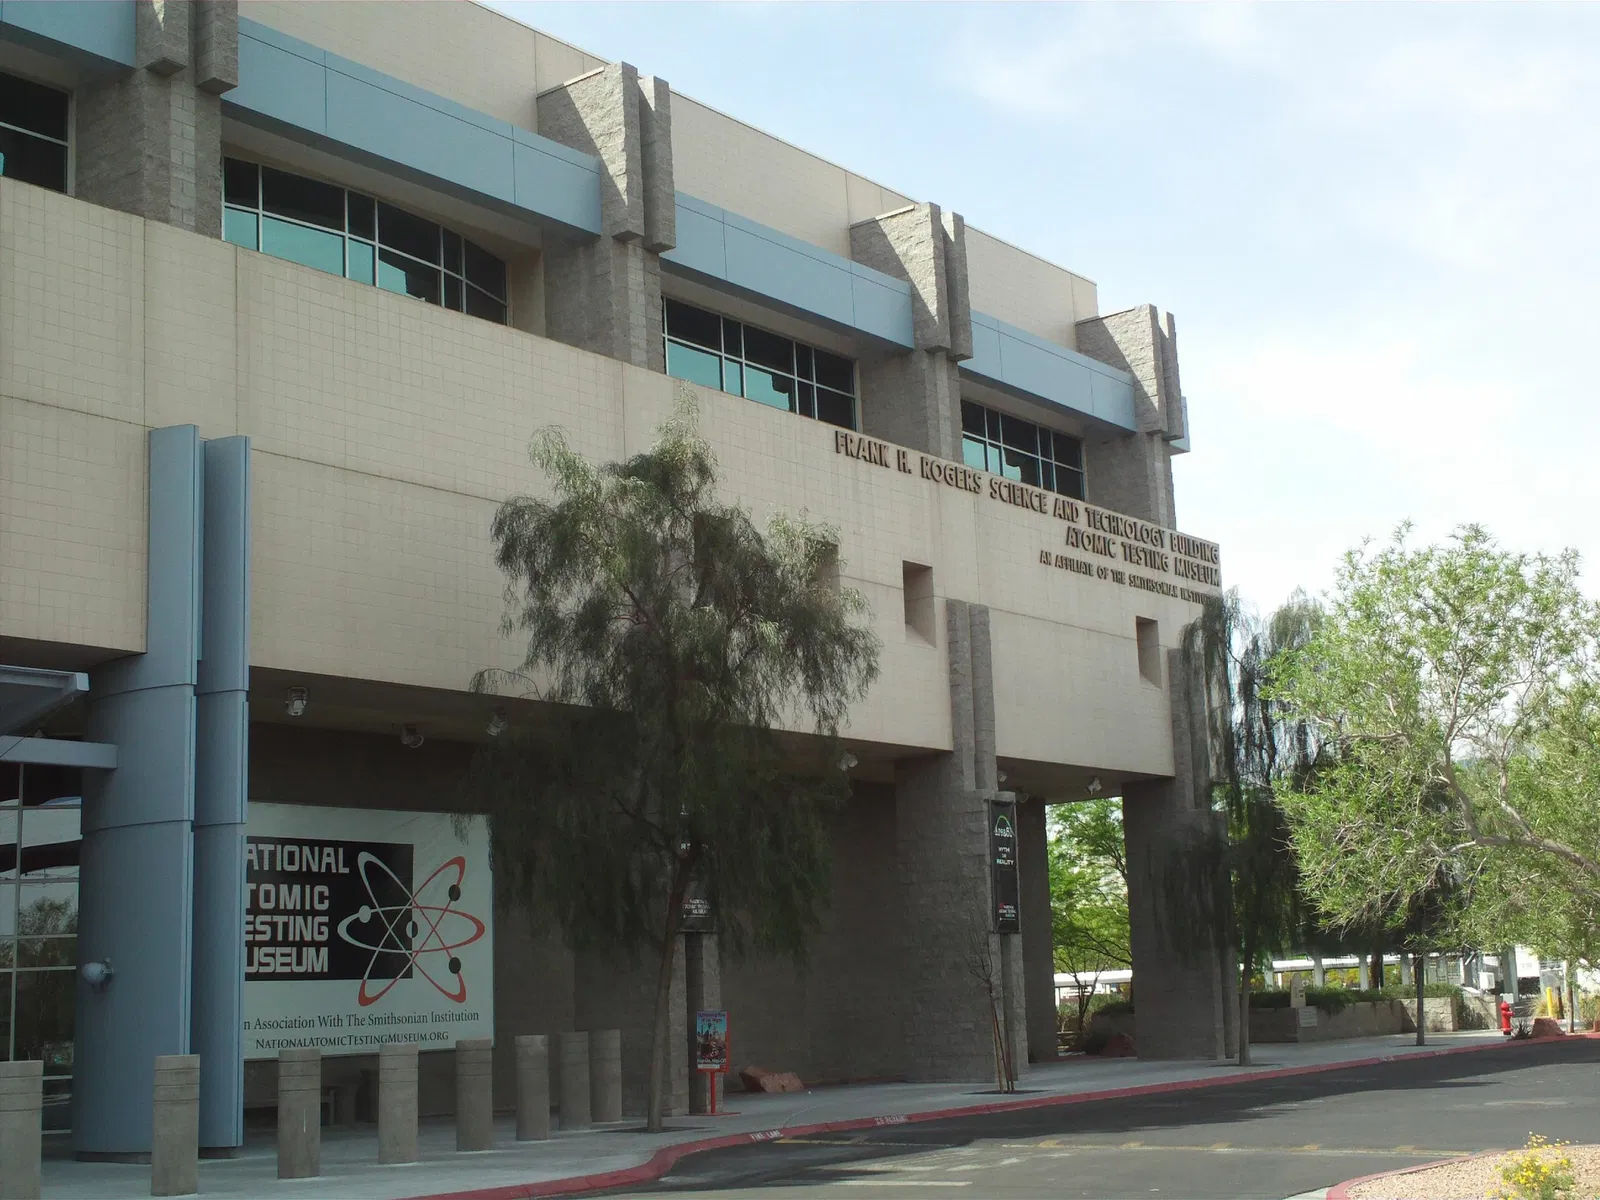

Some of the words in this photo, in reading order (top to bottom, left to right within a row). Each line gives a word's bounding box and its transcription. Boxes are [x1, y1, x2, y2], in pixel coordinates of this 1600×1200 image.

[835, 430, 890, 468] FRANK
[897, 449, 912, 474] H.
[920, 456, 982, 494] ROGERS
[990, 477, 1047, 514] SCIENCE
[1053, 497, 1079, 523] AND
[1085, 507, 1166, 549] TECHNOLOGY
[1170, 532, 1219, 564] BUILDING
[1066, 526, 1116, 558] ATOMIC
[1121, 541, 1169, 572] TESTING
[1175, 557, 1220, 587] MUSEUM
[1040, 550, 1051, 566] AN
[1055, 554, 1094, 577] AFFILIATE
[1097, 566, 1109, 580] OF
[1111, 569, 1125, 585] THE
[1129, 573, 1178, 598] SMITHSONIAN
[246, 844, 350, 874] ATIONAL
[246, 883, 330, 911] TOMIC
[245, 915, 329, 941] ESTING
[245, 947, 328, 973] USEUM
[254, 1016, 315, 1030] Association
[318, 1013, 343, 1027] With
[346, 1013, 365, 1026] The
[368, 1011, 428, 1026] Smithsonian
[431, 1009, 479, 1023] Institution
